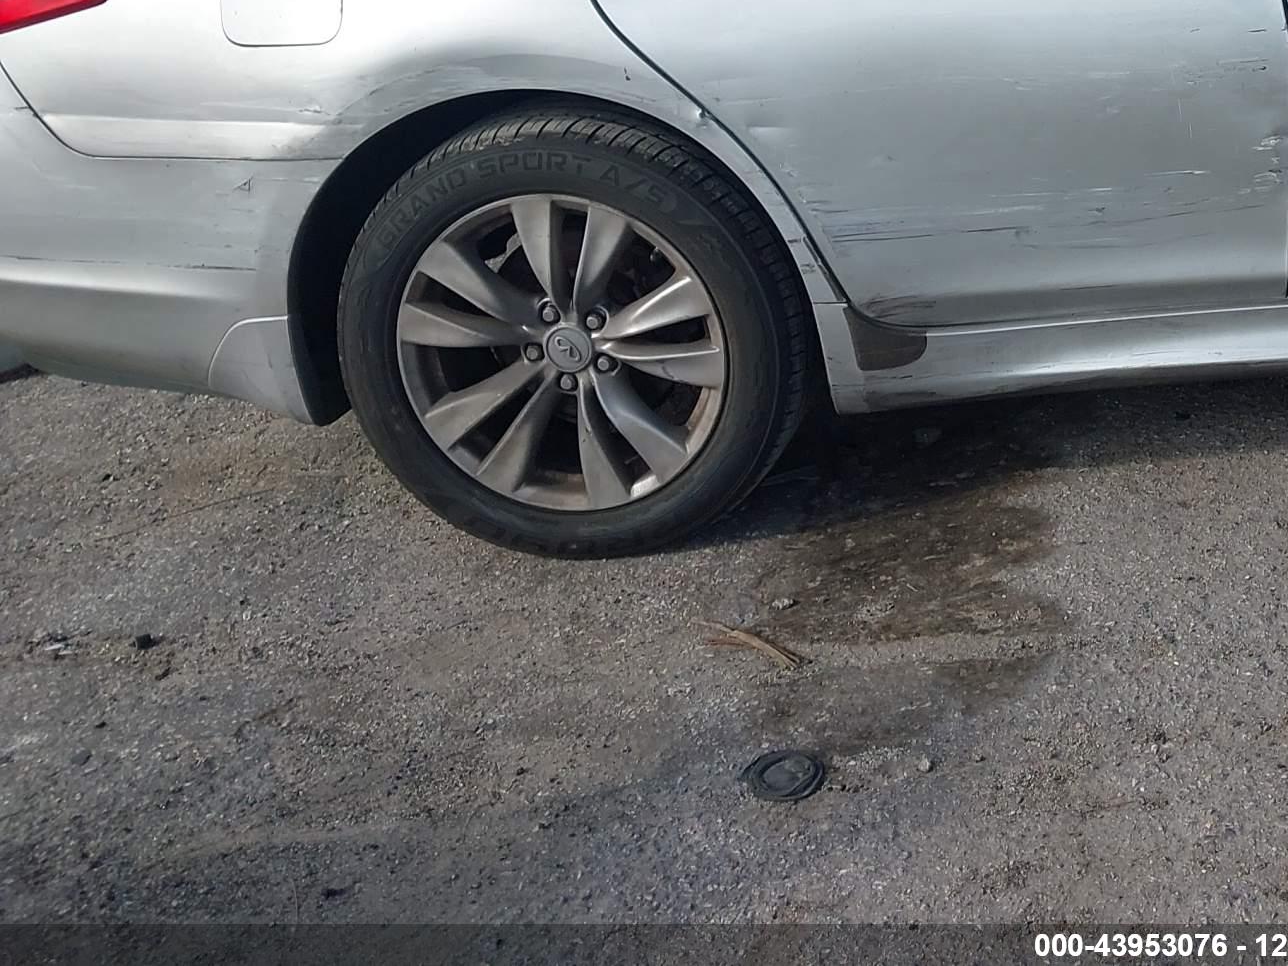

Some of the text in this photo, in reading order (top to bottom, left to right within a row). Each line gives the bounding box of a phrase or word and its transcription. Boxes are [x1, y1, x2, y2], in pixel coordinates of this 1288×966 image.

[379, 151, 668, 249] GRAND SPORT A/S
